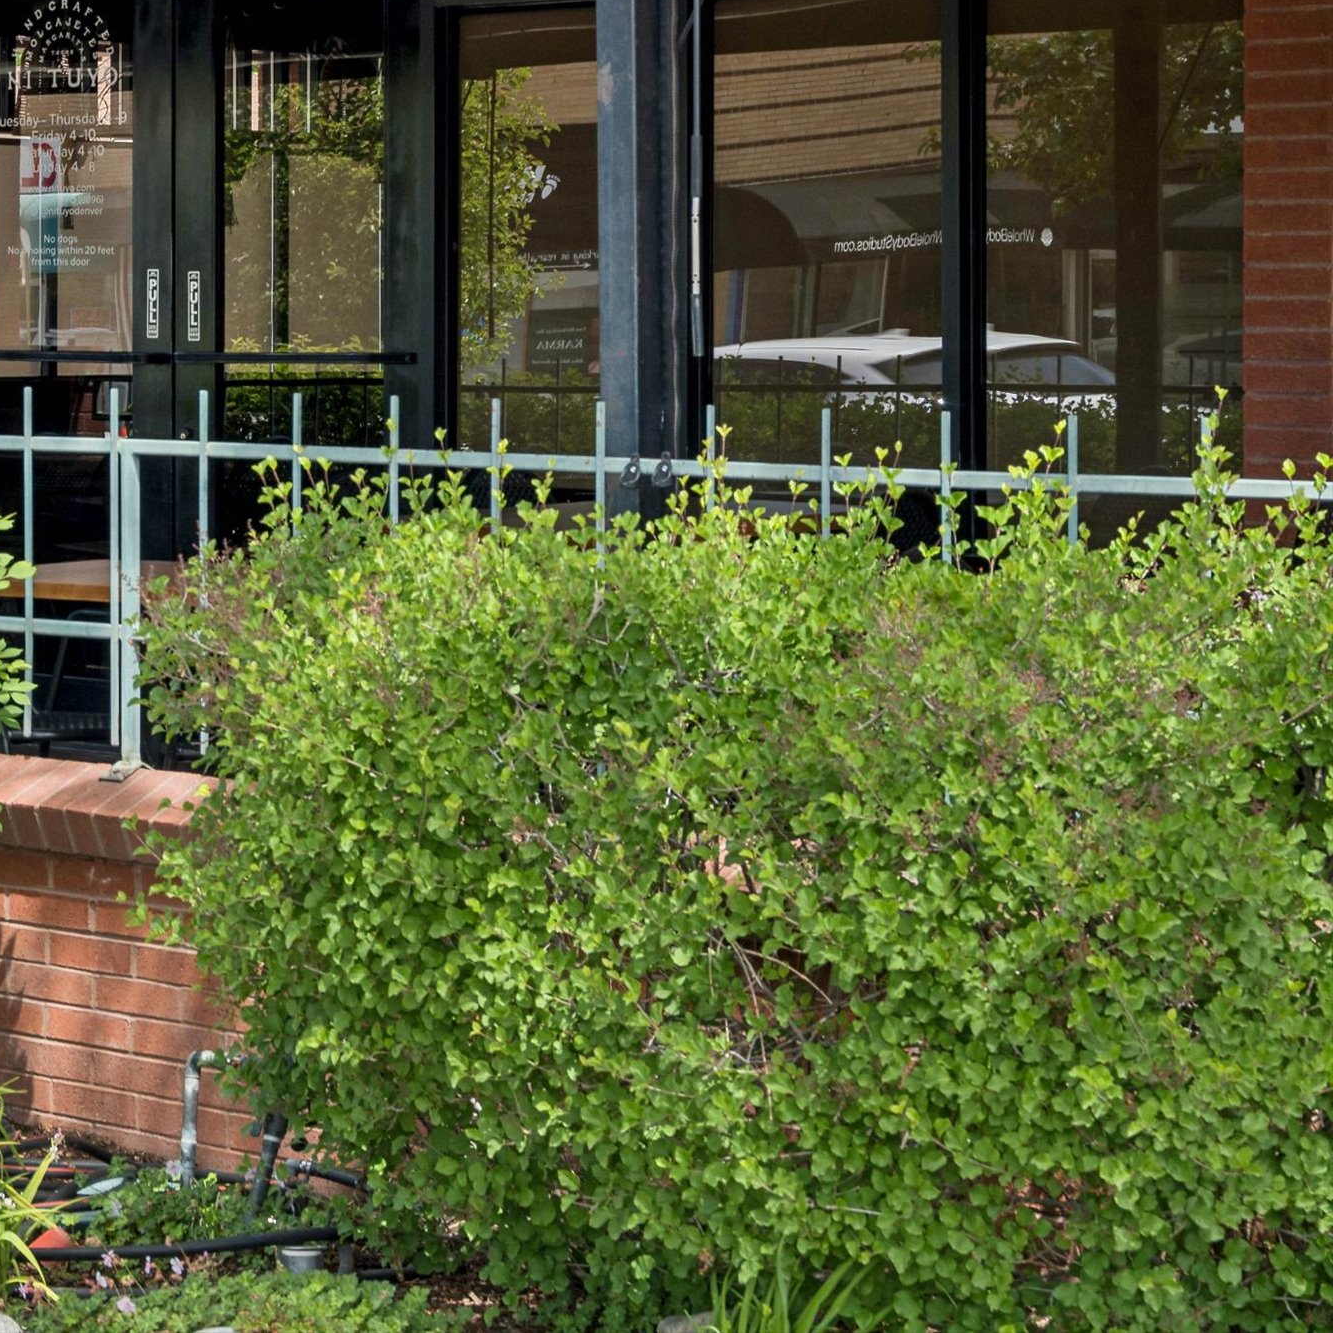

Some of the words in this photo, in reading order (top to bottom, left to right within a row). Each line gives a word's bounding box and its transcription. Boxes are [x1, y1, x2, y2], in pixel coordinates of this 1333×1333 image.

[12, 0, 114, 57] HANDCRAFTED
[27, 17, 99, 62] MOLCAJETES
[47, 67, 118, 89] TUYO
[31, 129, 67, 143] Friday
[69, 129, 77, 141] 4
[78, 144, 85, 156] 4
[31, 162, 68, 175] unday
[71, 161, 79, 172] 4
[89, 161, 95, 172] 8
[44, 235, 56, 243] No
[57, 234, 78, 245] dogs
[7, 246, 20, 255] No
[57, 246, 83, 255] within
[85, 245, 96, 255] 20
[97, 245, 115, 255] feet
[31, 257, 51, 266] from
[52, 257, 69, 266] this
[70, 257, 90, 266] door
[149, 278, 157, 323] PULL
[190, 281, 198, 326] PULL
